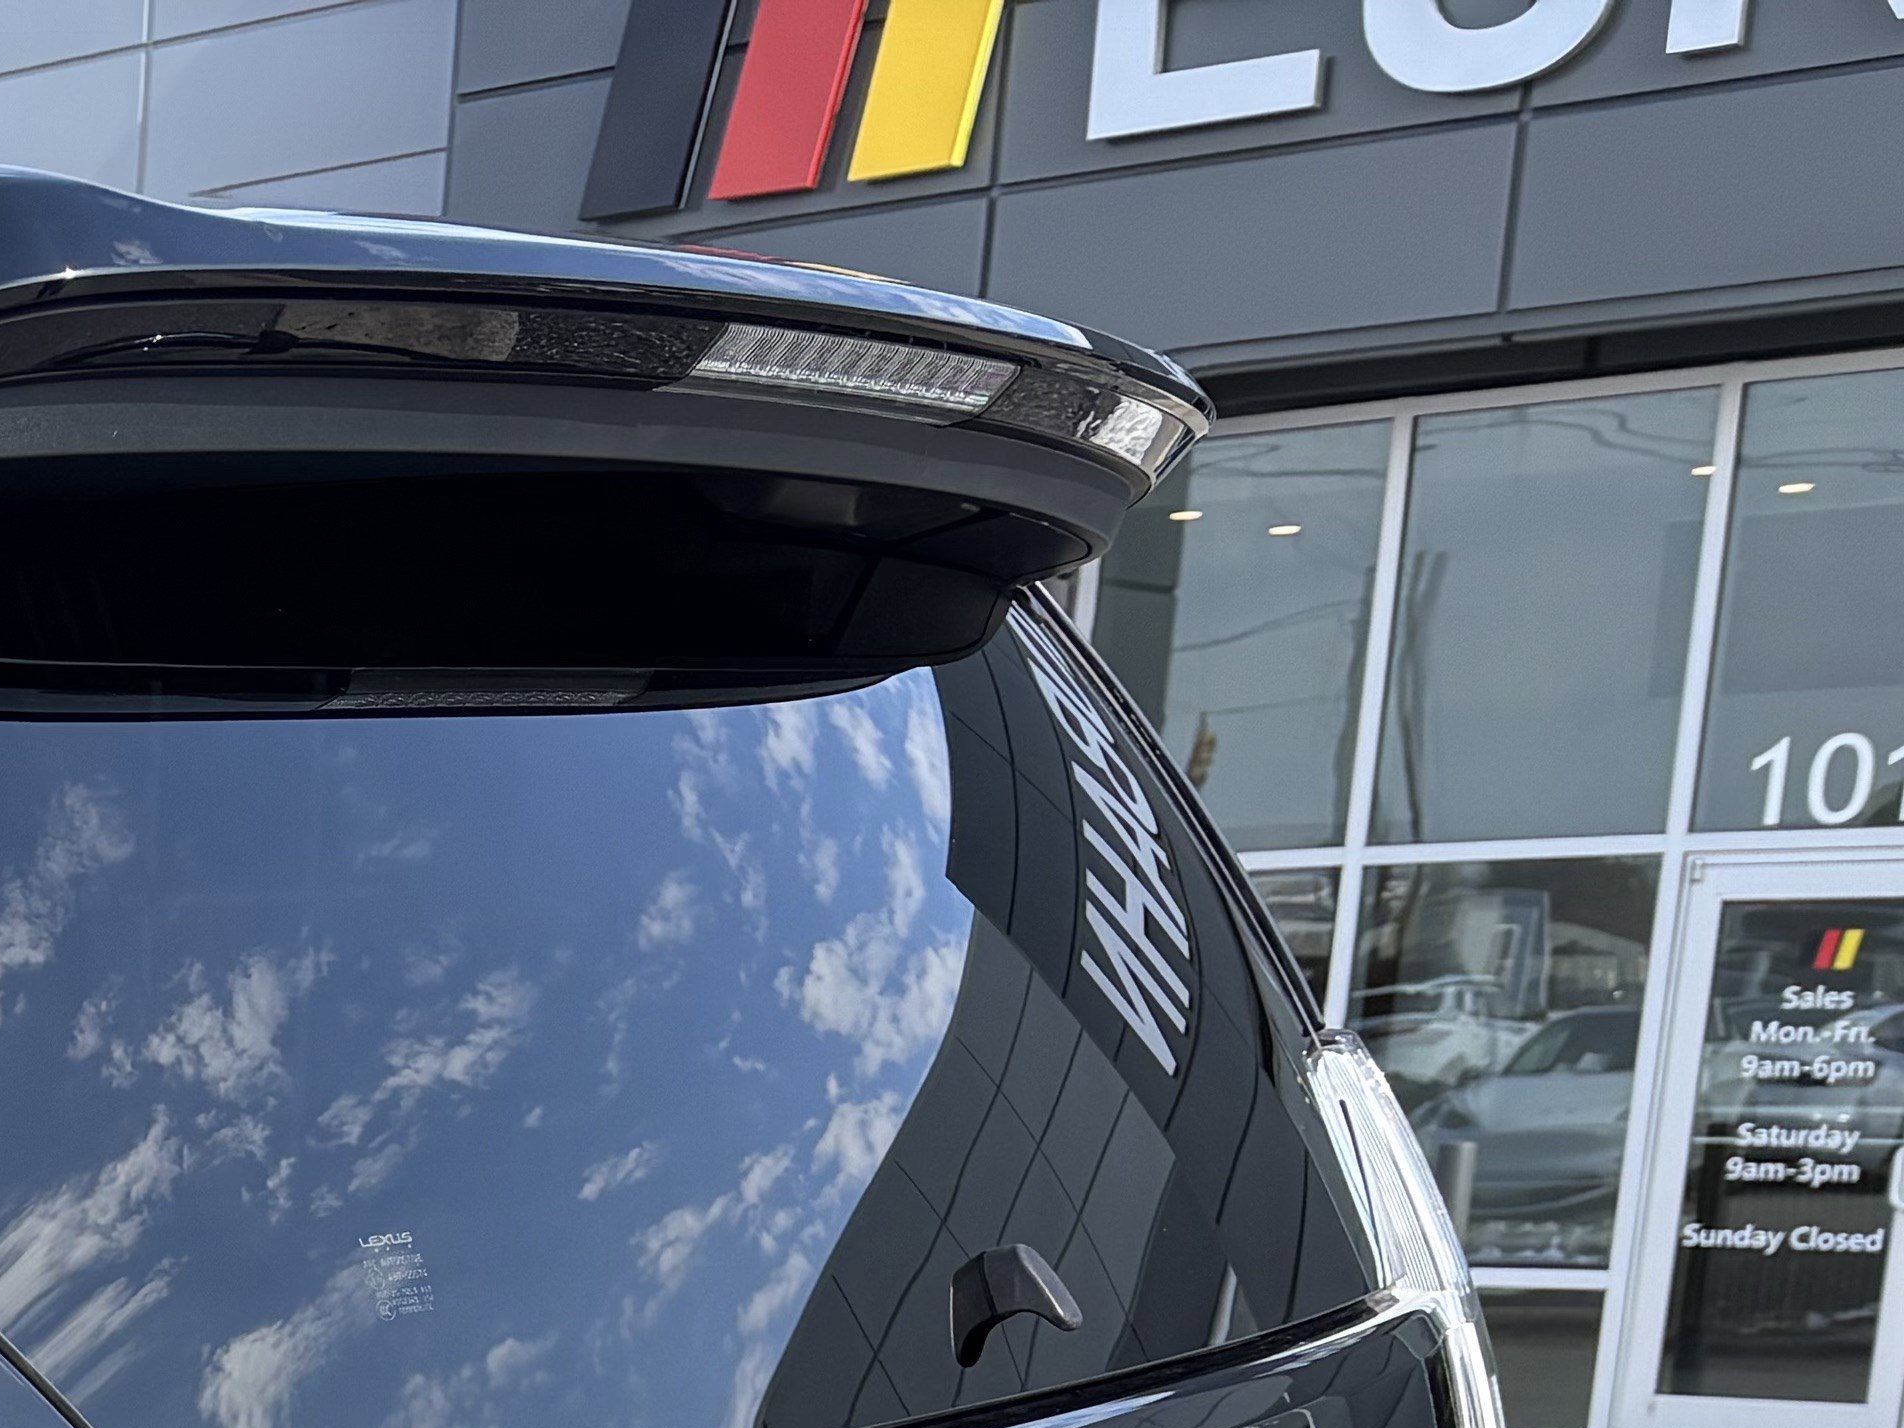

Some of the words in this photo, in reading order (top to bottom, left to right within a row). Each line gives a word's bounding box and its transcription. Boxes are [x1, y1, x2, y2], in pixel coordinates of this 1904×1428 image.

[1781, 985, 1855, 1010] Sales
[1749, 1020, 1876, 1044] Mon.-Fri.
[1740, 1054, 1875, 1084] 9am-6pm
[1736, 1123, 1861, 1154] Saturday
[1724, 1156, 1862, 1188] 9am-3pm
[359, 1231, 413, 1248] LEXUS
[1682, 1223, 1786, 1256] Sunday
[1789, 1225, 1885, 1252] Closed
